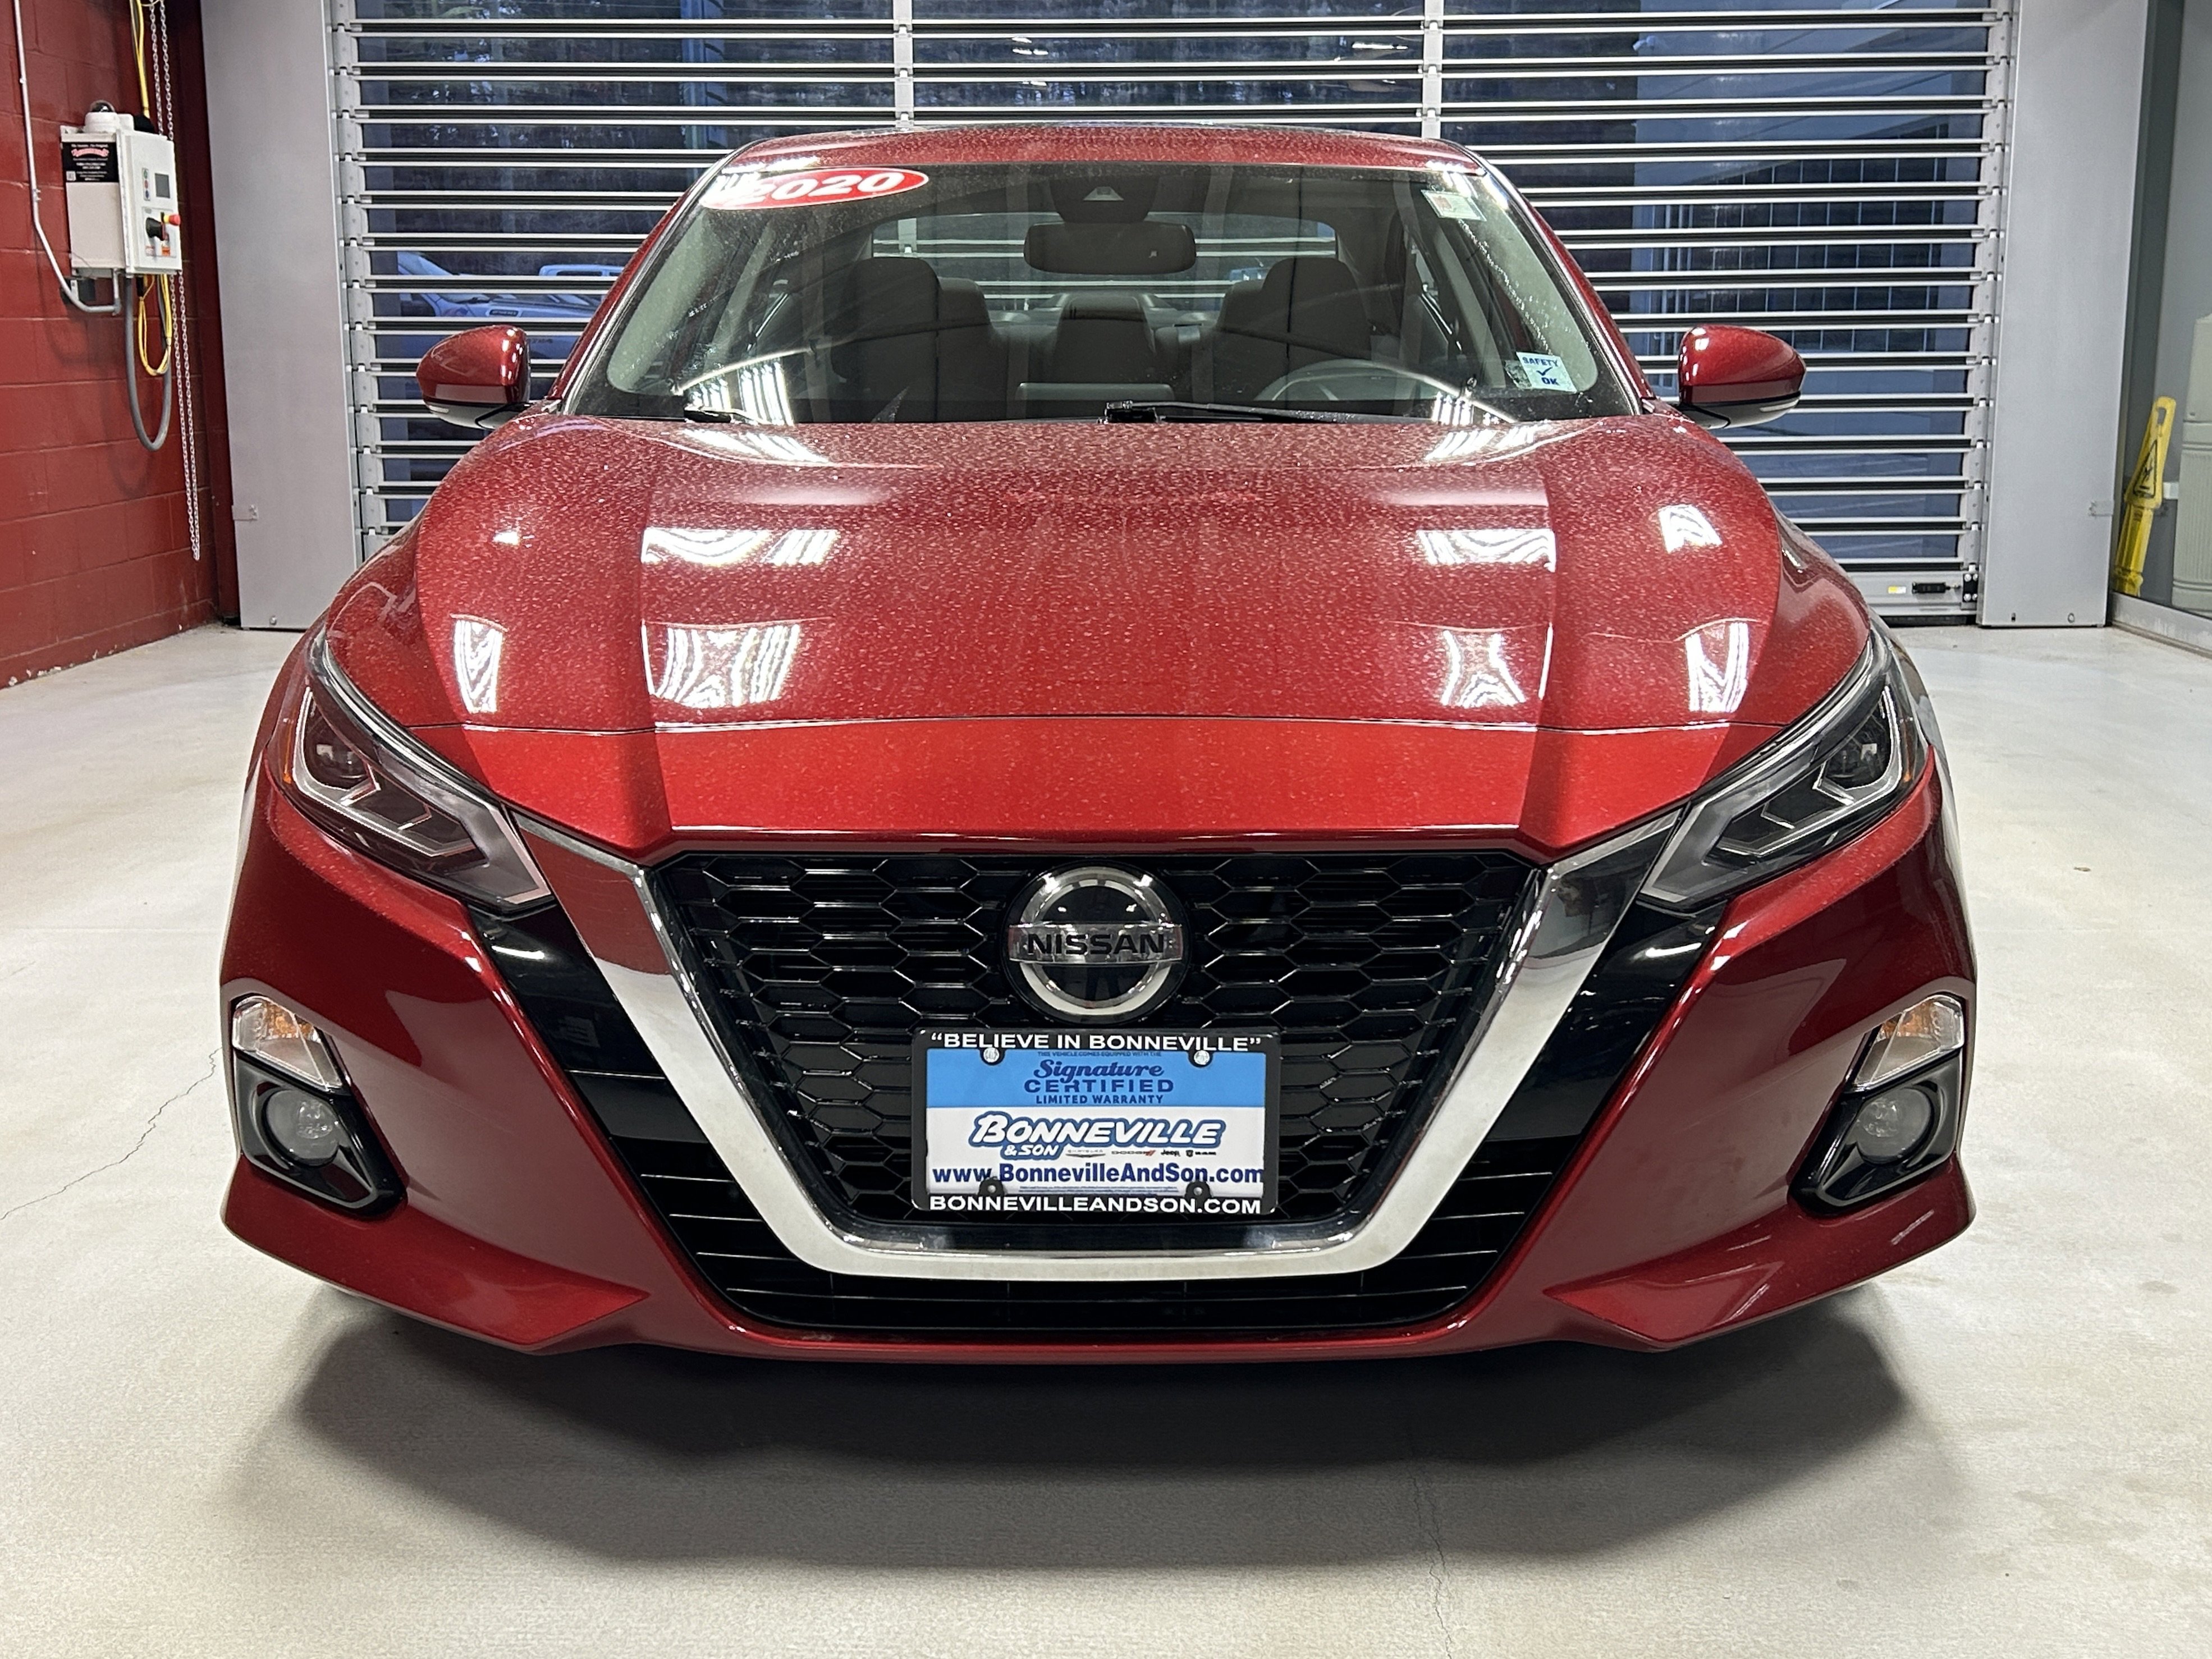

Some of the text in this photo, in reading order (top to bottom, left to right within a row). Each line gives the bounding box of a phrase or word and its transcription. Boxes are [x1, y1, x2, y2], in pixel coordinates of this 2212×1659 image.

[1522, 356, 1559, 366] SAFETY
[1541, 377, 1560, 386] OK
[1028, 933, 1164, 955] NISSAN
[931, 1033, 1261, 1052] “BELIEVE IN BONNEVILLE”
[1033, 1059, 1165, 1083] Signature
[1024, 1079, 1174, 1093] CERTIFIED
[1036, 1095, 1164, 1104] LIMITED WARRANTY
[1004, 1144, 1059, 1156] & SON
[932, 1162, 1264, 1183] wwwBonnevilleAndSon.com
[930, 1196, 1261, 1214] BONNEVILLEANDSON.COM
